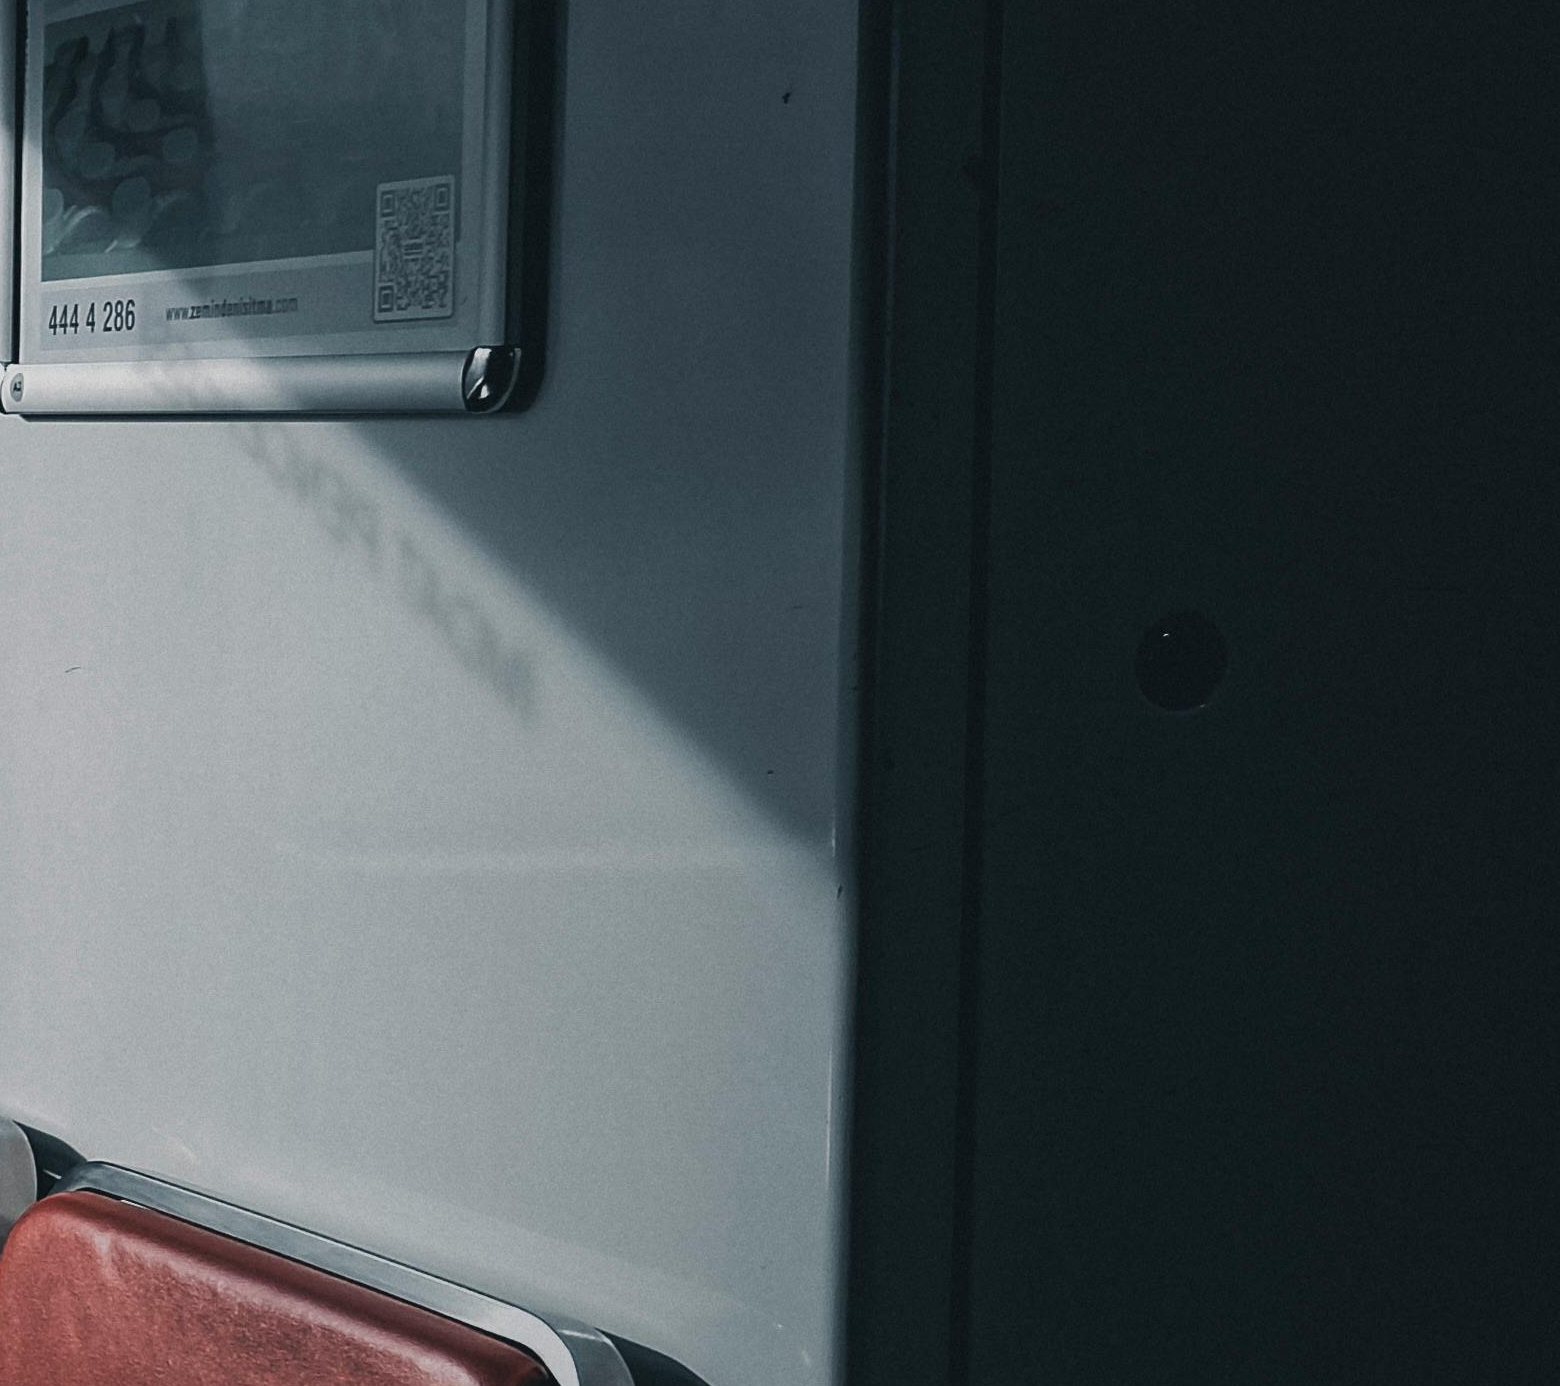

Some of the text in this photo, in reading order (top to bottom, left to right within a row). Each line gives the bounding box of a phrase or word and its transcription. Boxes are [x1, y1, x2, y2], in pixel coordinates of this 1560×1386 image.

[48, 304, 79, 336] 444
[86, 302, 96, 333] 4
[102, 299, 136, 332] 286
